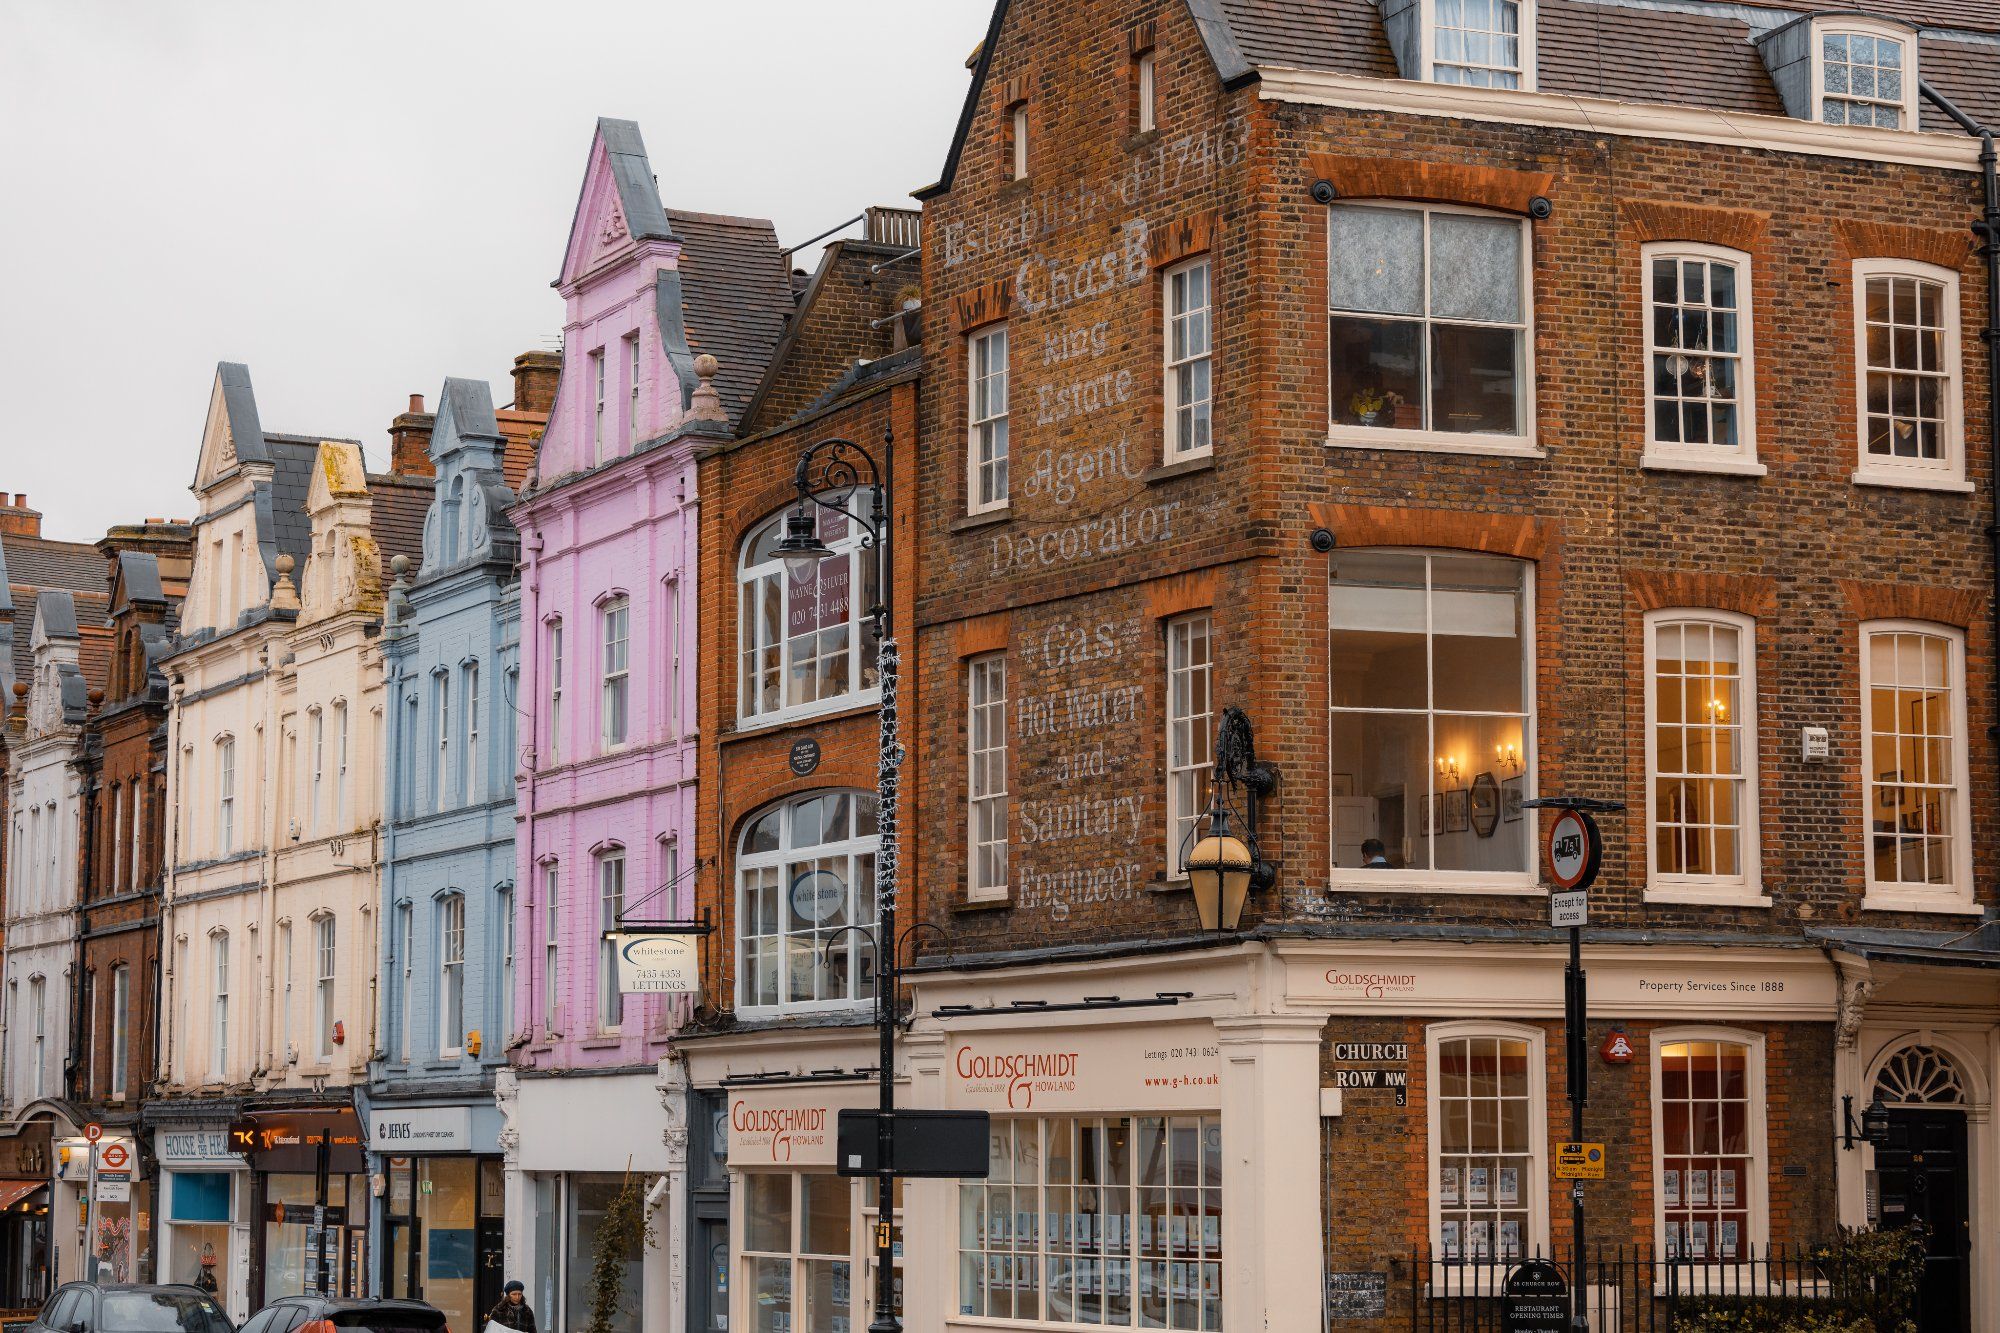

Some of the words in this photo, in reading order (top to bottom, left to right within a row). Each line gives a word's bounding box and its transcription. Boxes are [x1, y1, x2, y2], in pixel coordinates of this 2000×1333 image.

[1015, 251, 1119, 312] Chas
[1036, 369, 1134, 426] Estate
[1024, 431, 1144, 504] Agent
[990, 501, 1180, 576] Decorator
[1017, 693, 1056, 738] Hot
[1067, 684, 1143, 732] Water
[1056, 742, 1104, 780] and
[1020, 793, 1146, 846] Sanitary
[1554, 898, 1575, 909] Except
[1576, 896, 1585, 906] for
[1559, 911, 1580, 921] access
[637, 969, 657, 979] 7435
[632, 980, 686, 990] LETTINGS
[1639, 980, 1683, 993] Property
[1687, 980, 1727, 991] Services
[1730, 981, 1756, 992] Since
[1760, 982, 1784, 992] 1888
[1170, 1048, 1183, 1058] 020
[1202, 1046, 1219, 1057] 0624
[1335, 1043, 1408, 1060] CHURCH
[1034, 1080, 1076, 1093] HOWLAND
[1145, 1073, 1219, 1089] www.g-h.co.uk
[1336, 1071, 1377, 1087] ROW
[89, 1125, 101, 1139] D
[388, 1123, 410, 1139] JEEVES
[165, 1135, 197, 1156] HOUSE
